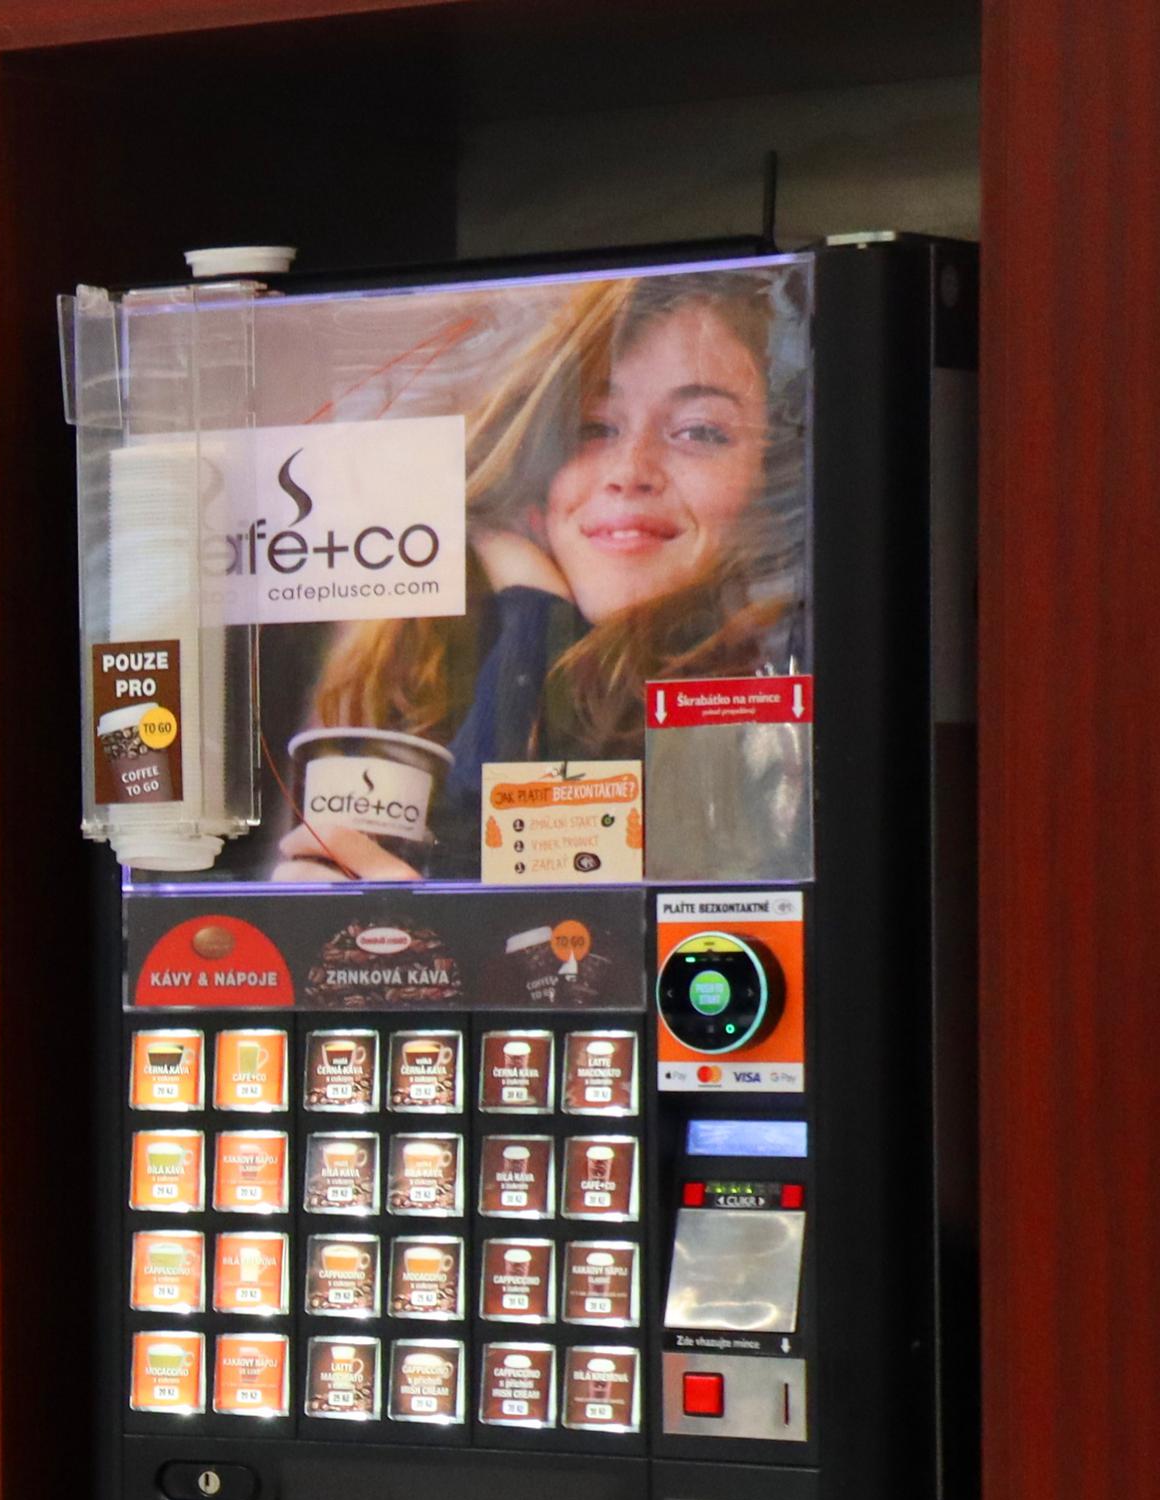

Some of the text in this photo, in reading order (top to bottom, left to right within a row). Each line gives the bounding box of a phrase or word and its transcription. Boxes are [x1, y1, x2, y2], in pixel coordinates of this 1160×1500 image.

[268, 579, 440, 602] cafeplusco.com
[103, 652, 169, 672] POUZE
[116, 678, 156, 698] PRO
[676, 692, 782, 707] Škrabátko na mince
[143, 721, 172, 734] TO GO
[121, 766, 159, 783] COFFEE
[126, 781, 159, 796] TO GO
[150, 968, 278, 987] KÁVY & NÁPOJE
[326, 967, 450, 984] ZRNKOVÁ KÁVA
[734, 1071, 761, 1083] VISA
[726, 1196, 757, 1206] CUKR
[676, 1335, 694, 1347] Zde
[733, 1338, 761, 1349] mince
